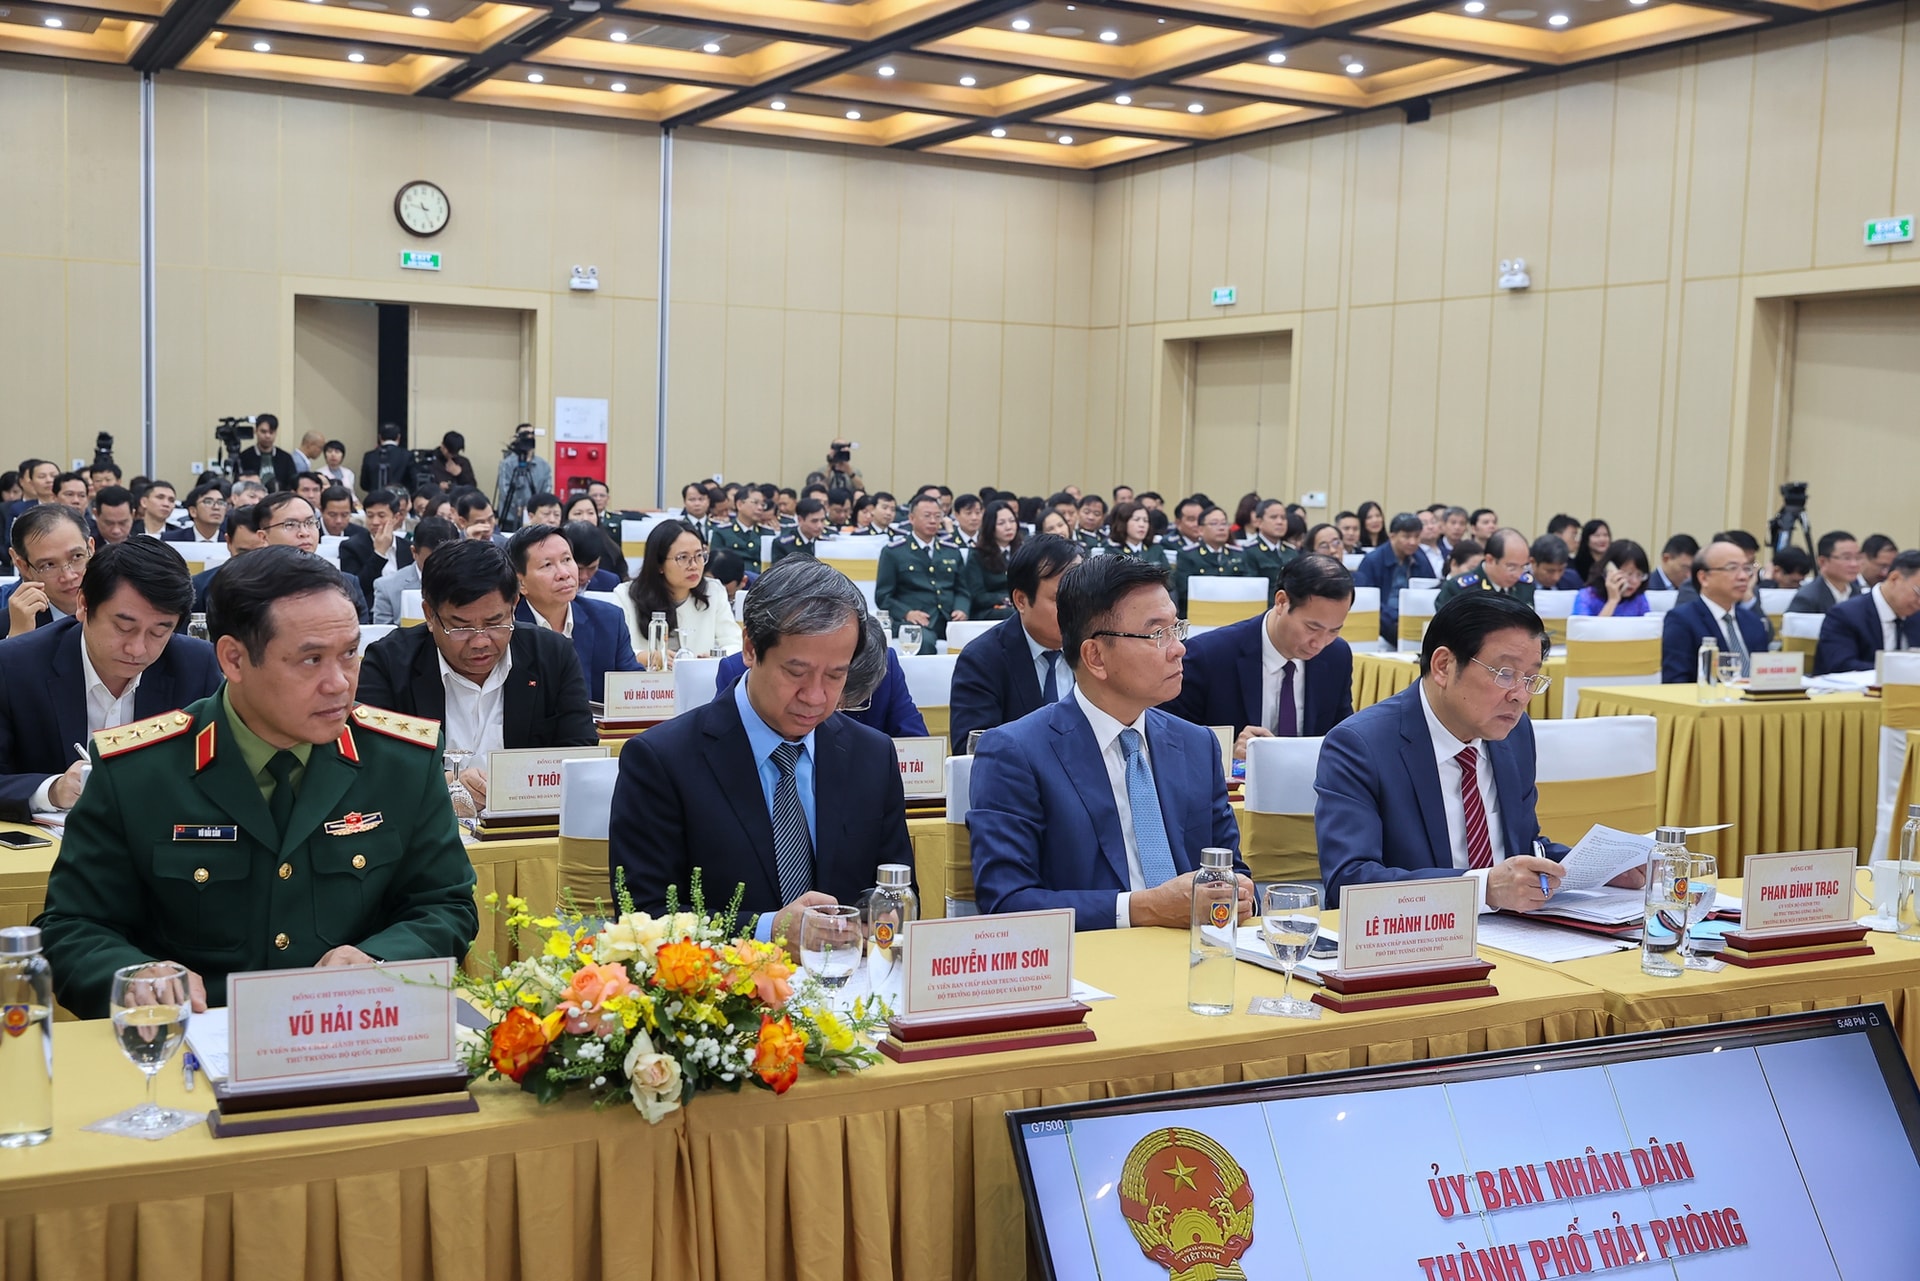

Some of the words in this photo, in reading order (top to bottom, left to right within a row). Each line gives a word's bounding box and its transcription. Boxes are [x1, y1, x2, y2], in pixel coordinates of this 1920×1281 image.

[909, 758, 924, 773] TÀI
[528, 774, 534, 787] Y
[537, 771, 561, 787] THÔN
[1761, 884, 1788, 901] PHAN
[1790, 880, 1813, 899] ĐÌNH
[1815, 880, 1839, 899] TRẠC
[1365, 915, 1379, 937] LÊ
[1383, 913, 1422, 935] THÀNH
[1425, 912, 1455, 931] LONG
[974, 930, 995, 940] ĐỒNG
[996, 930, 1009, 938] CHÍ
[932, 948, 987, 976] NGUYỄN
[991, 951, 1017, 971] KIM
[1021, 947, 1049, 968] SƠN
[289, 1009, 314, 1036] VŨ
[321, 1003, 353, 1033] HẢI
[360, 1000, 399, 1029] SẢN
[1837, 1018, 1853, 1028] 5:48
[1853, 1016, 1866, 1026] PM
[1031, 1119, 1064, 1133] G7500
[1427, 1162, 1472, 1219] ỦY
[1475, 1164, 1545, 1211] BAN
[1544, 1145, 1632, 1200] NHÂN
[1629, 1136, 1696, 1187] DÂN
[1418, 1241, 1528, 1281] THÀNH
[1528, 1216, 1593, 1281] PHỐ
[1593, 1211, 1651, 1270] HẢI
[1649, 1204, 1749, 1259] PHÒNG
[1181, 1251, 1200, 1264] VIỆT
[1201, 1250, 1220, 1260] NAM
